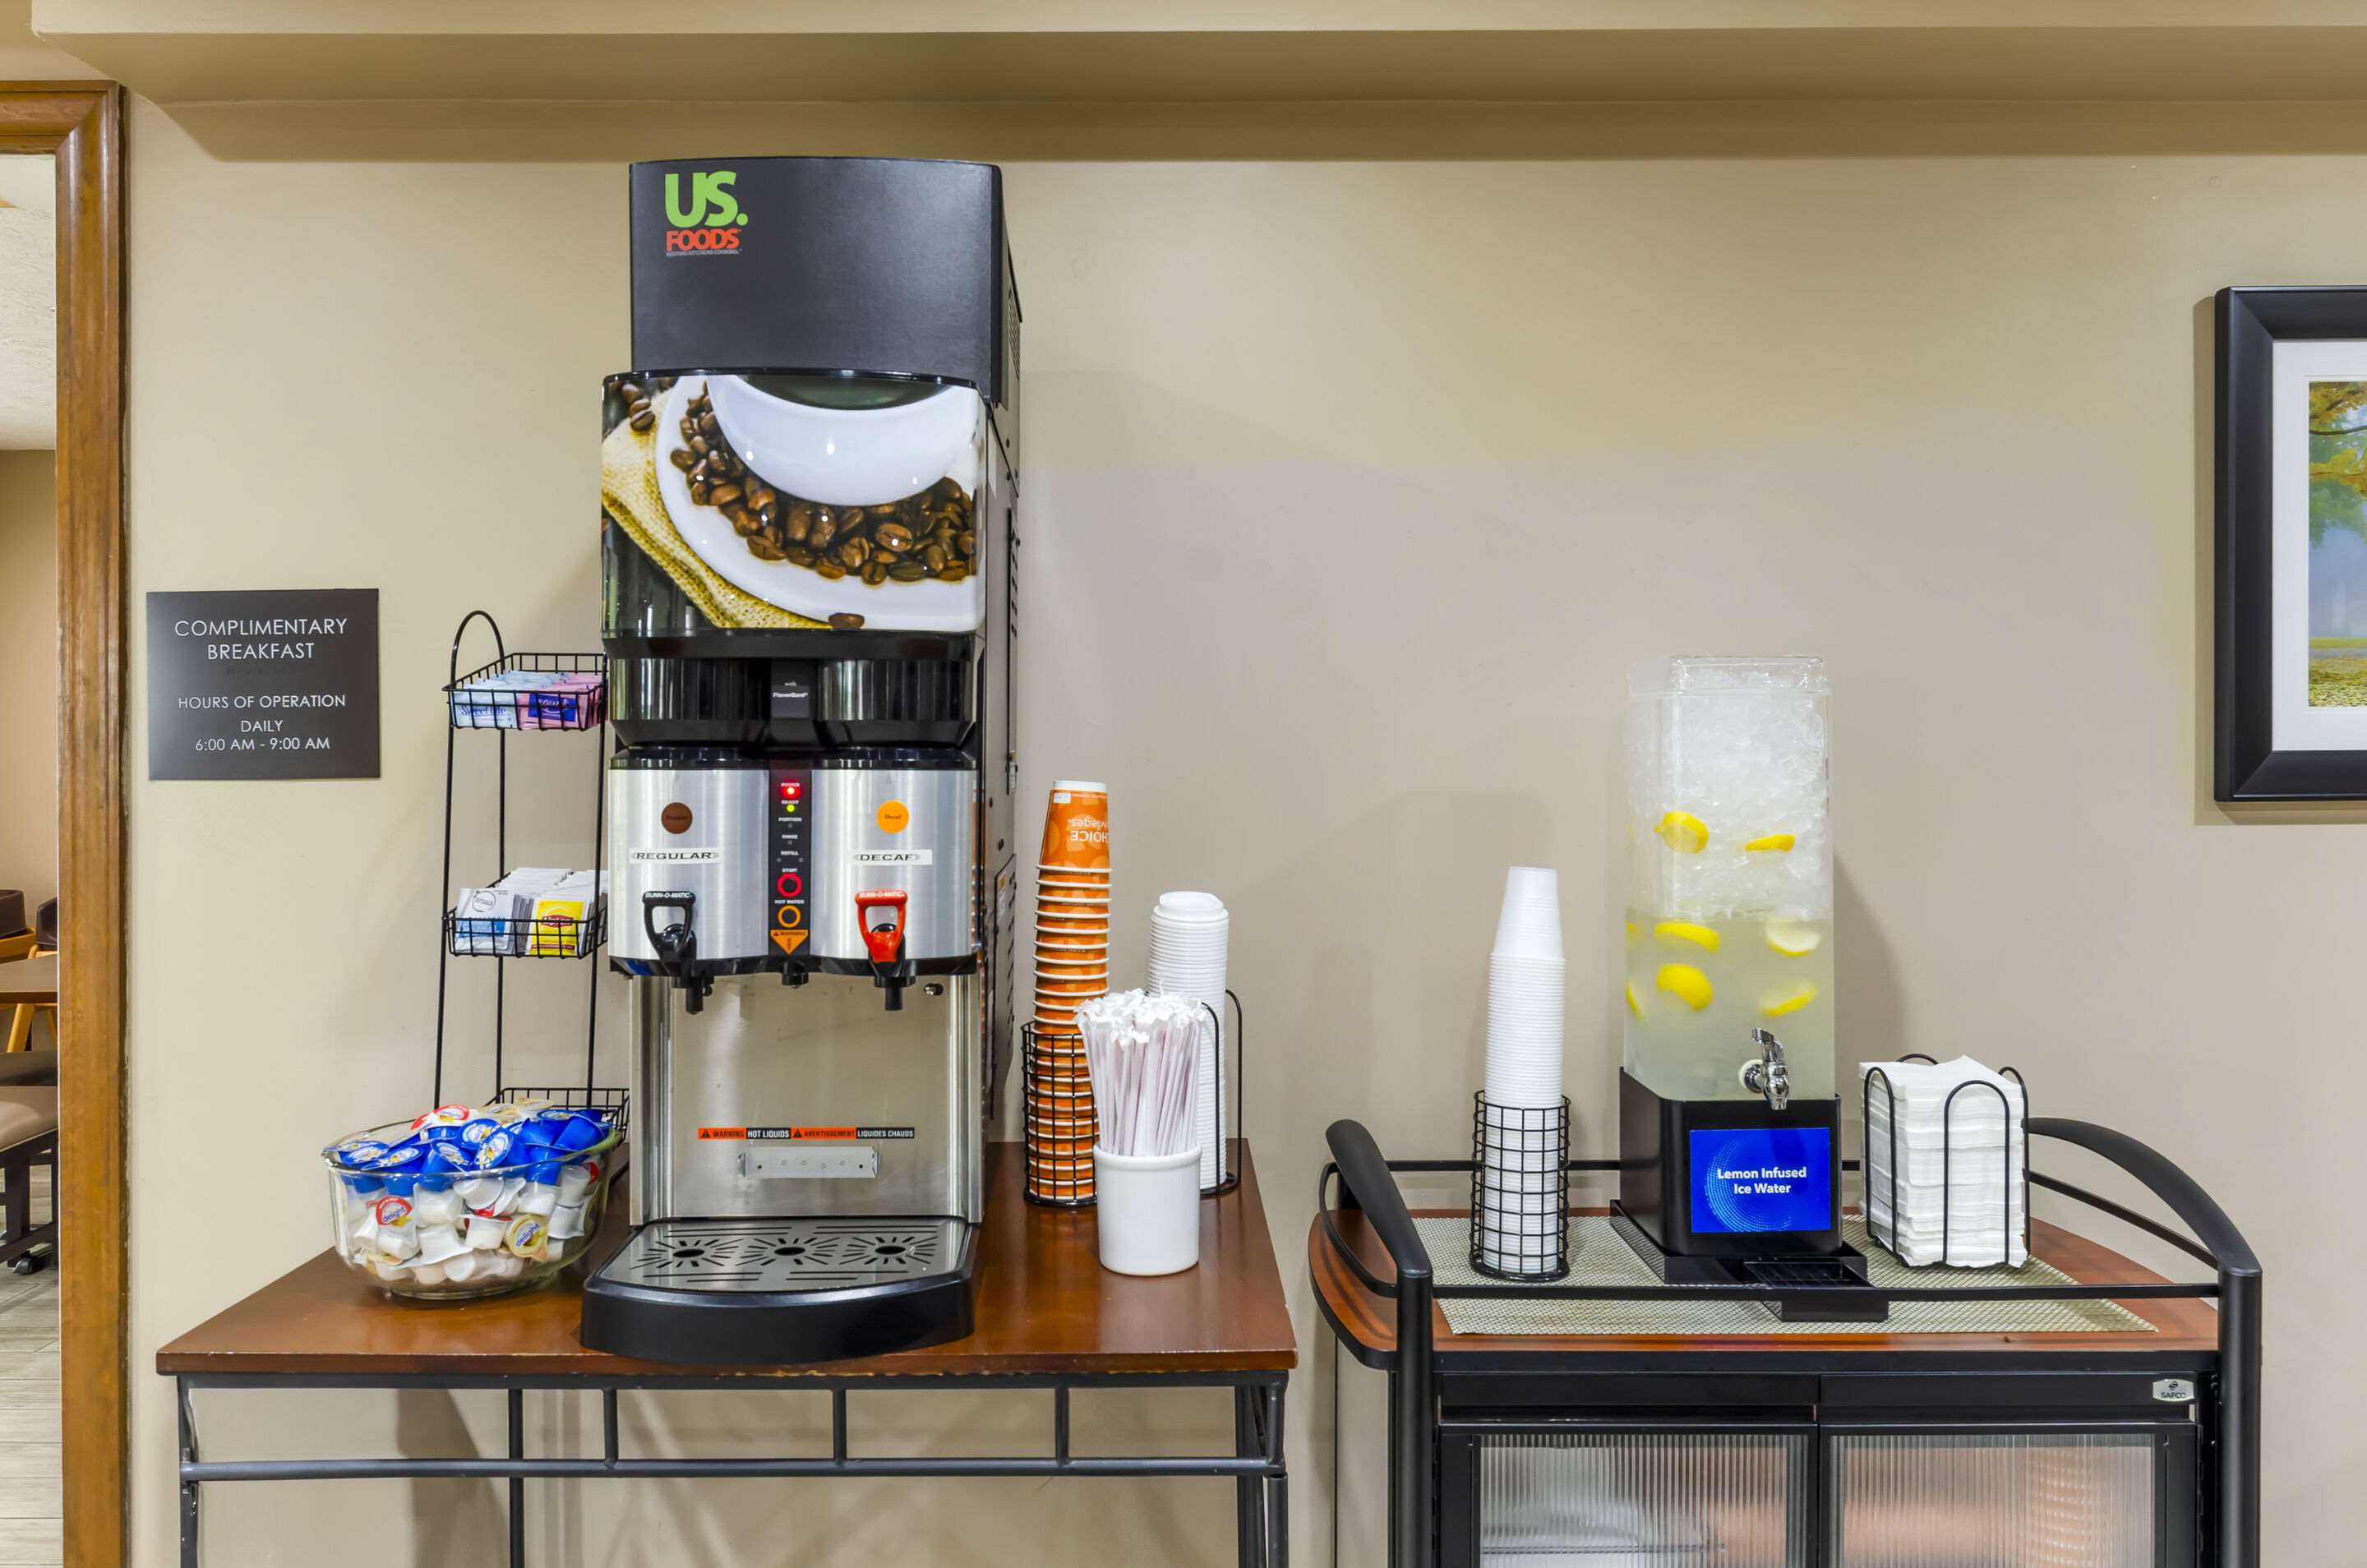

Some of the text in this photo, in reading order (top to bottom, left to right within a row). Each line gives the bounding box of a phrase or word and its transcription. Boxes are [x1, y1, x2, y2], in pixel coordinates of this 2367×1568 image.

[667, 228, 741, 251] FOODS
[174, 618, 348, 637] COMPLIMENTARY
[207, 643, 315, 660] BREAKFAST
[178, 694, 346, 709] HOURS OF OPERATION
[241, 720, 284, 732] DAILY
[196, 738, 226, 751] 6:00
[230, 739, 256, 750] AM
[270, 737, 301, 750] 9:00
[305, 737, 330, 749] AM
[1070, 830, 1109, 842] HOICE
[713, 1130, 790, 1138] WARNING HOT LIQUIDS
[857, 1129, 886, 1137] LIQUIDES
[888, 1129, 914, 1137] CHAUDS
[1717, 1166, 1807, 1179] Lemon Infused
[1734, 1183, 1792, 1194] Ice Water
[383, 1206, 406, 1223] delight
[515, 1223, 539, 1247] delight
